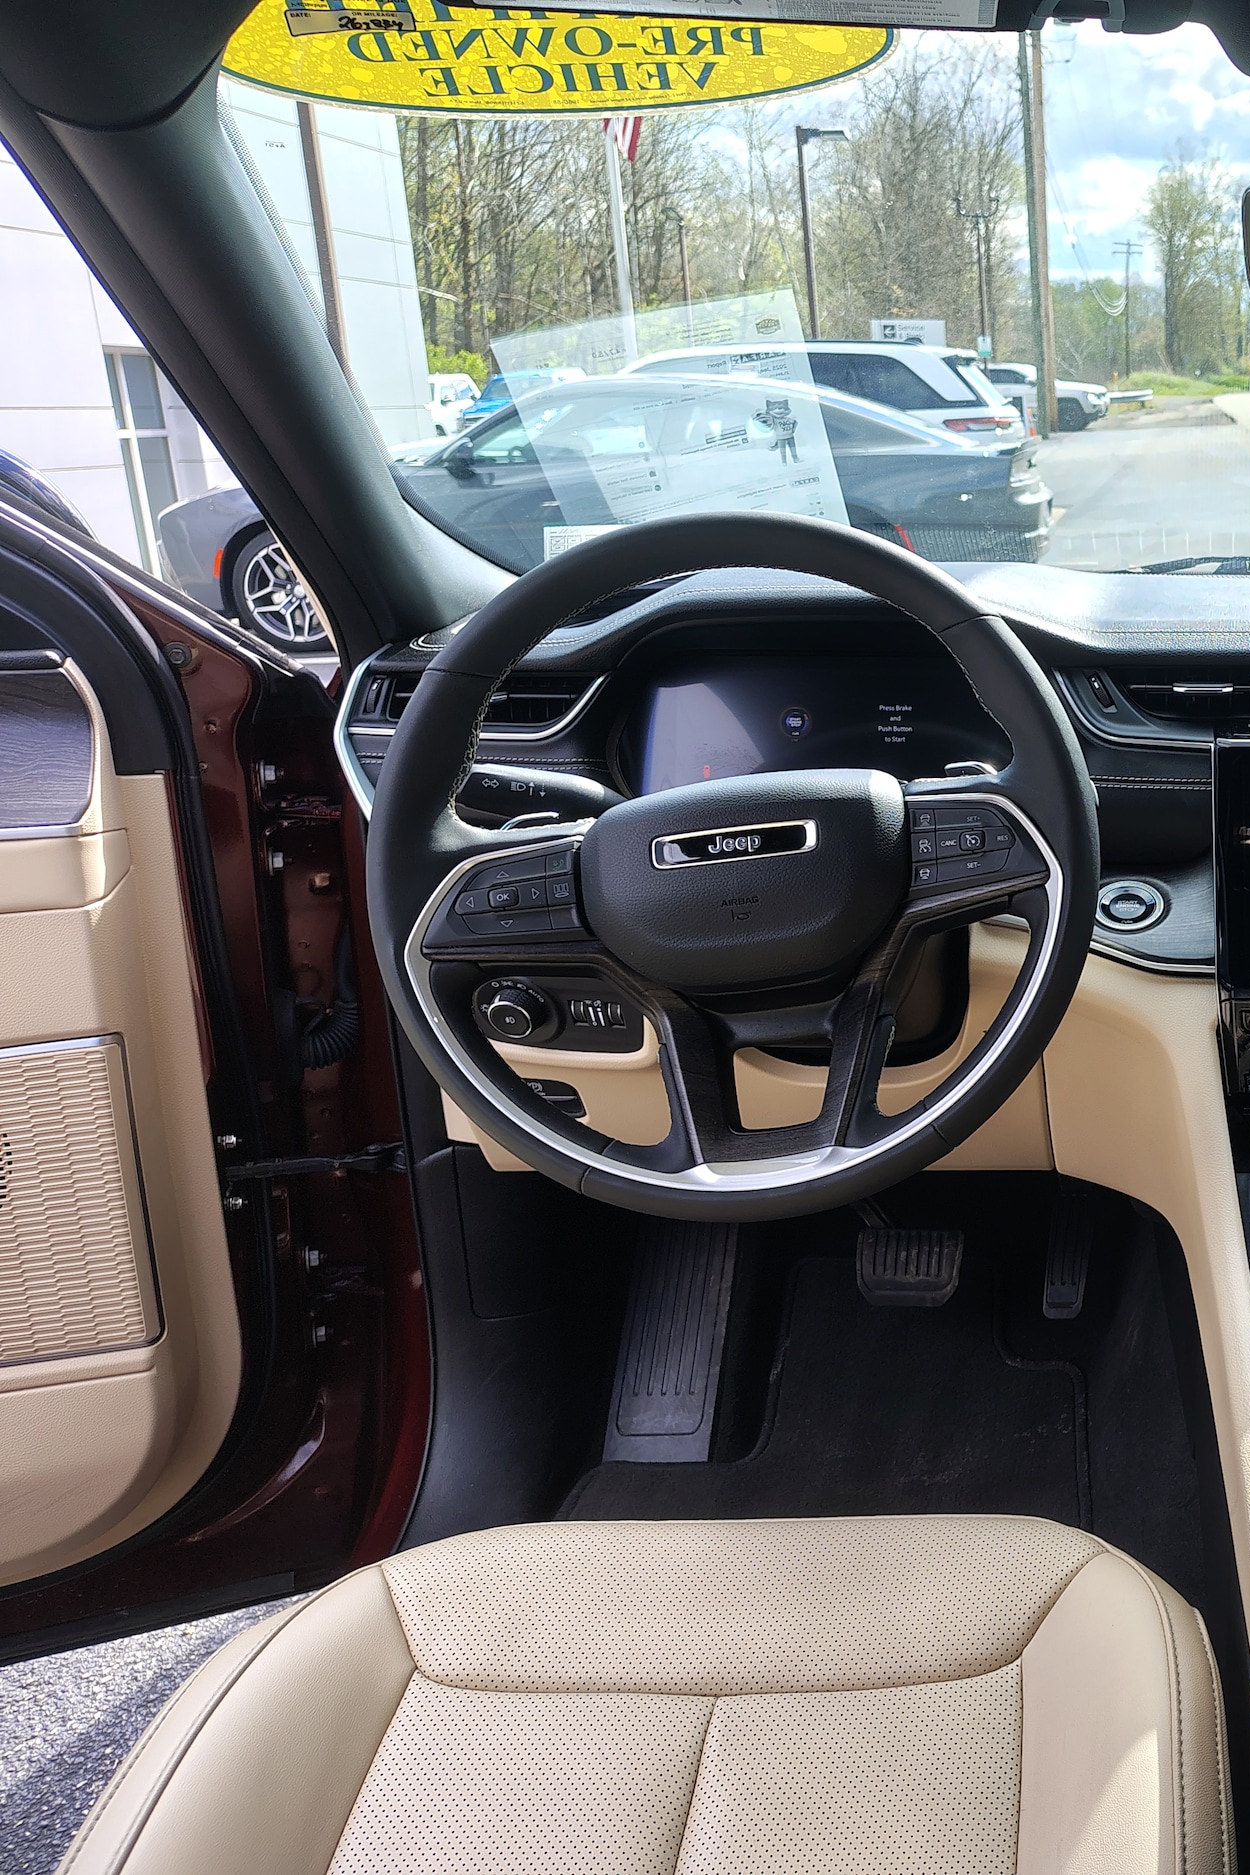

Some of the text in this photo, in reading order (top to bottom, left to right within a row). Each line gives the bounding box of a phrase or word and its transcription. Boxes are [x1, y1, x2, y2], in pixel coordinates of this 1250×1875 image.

[708, 835, 761, 854] Jeep
[721, 896, 760, 908] AIRBAG
[528, 989, 544, 1003] AUTO
